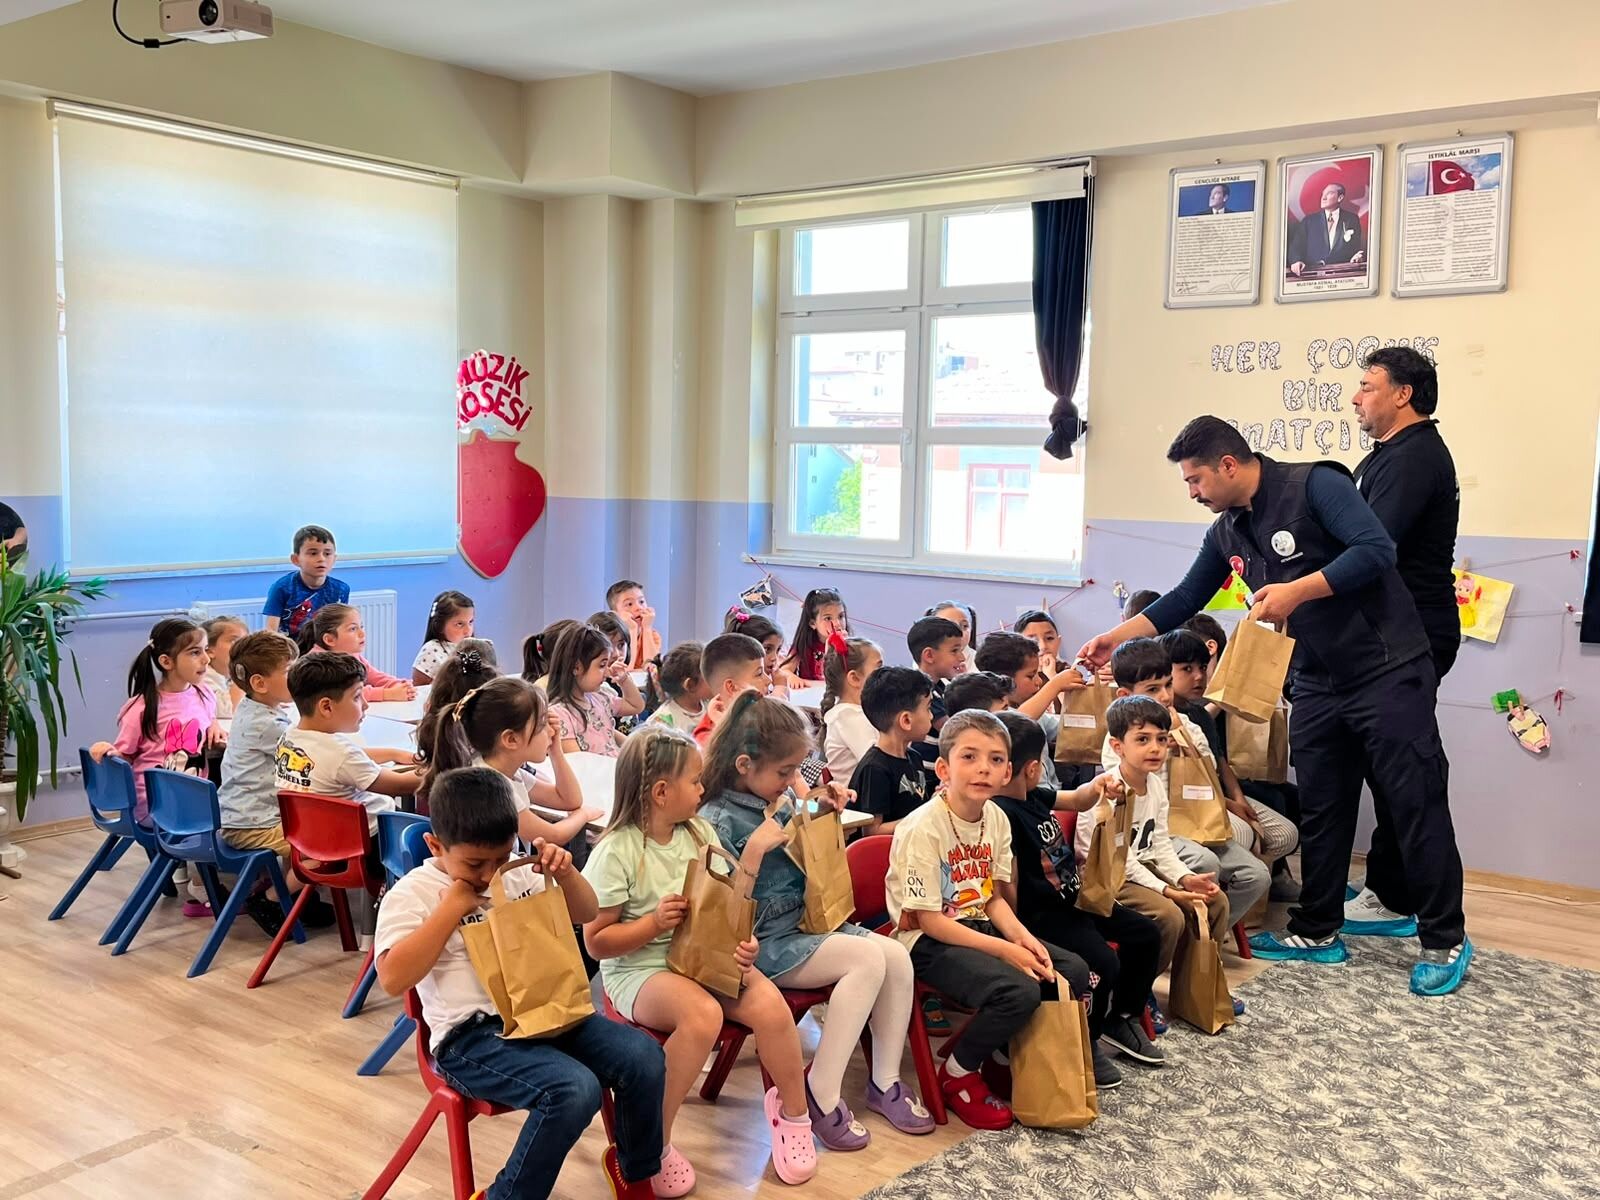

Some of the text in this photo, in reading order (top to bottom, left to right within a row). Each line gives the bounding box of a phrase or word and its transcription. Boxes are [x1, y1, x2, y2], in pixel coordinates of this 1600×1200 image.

[1211, 336, 1439, 374] HER ÇOCK
[1283, 378, 1343, 412] BİR
[904, 887, 927, 898] ING
[906, 876, 924, 887] ON
